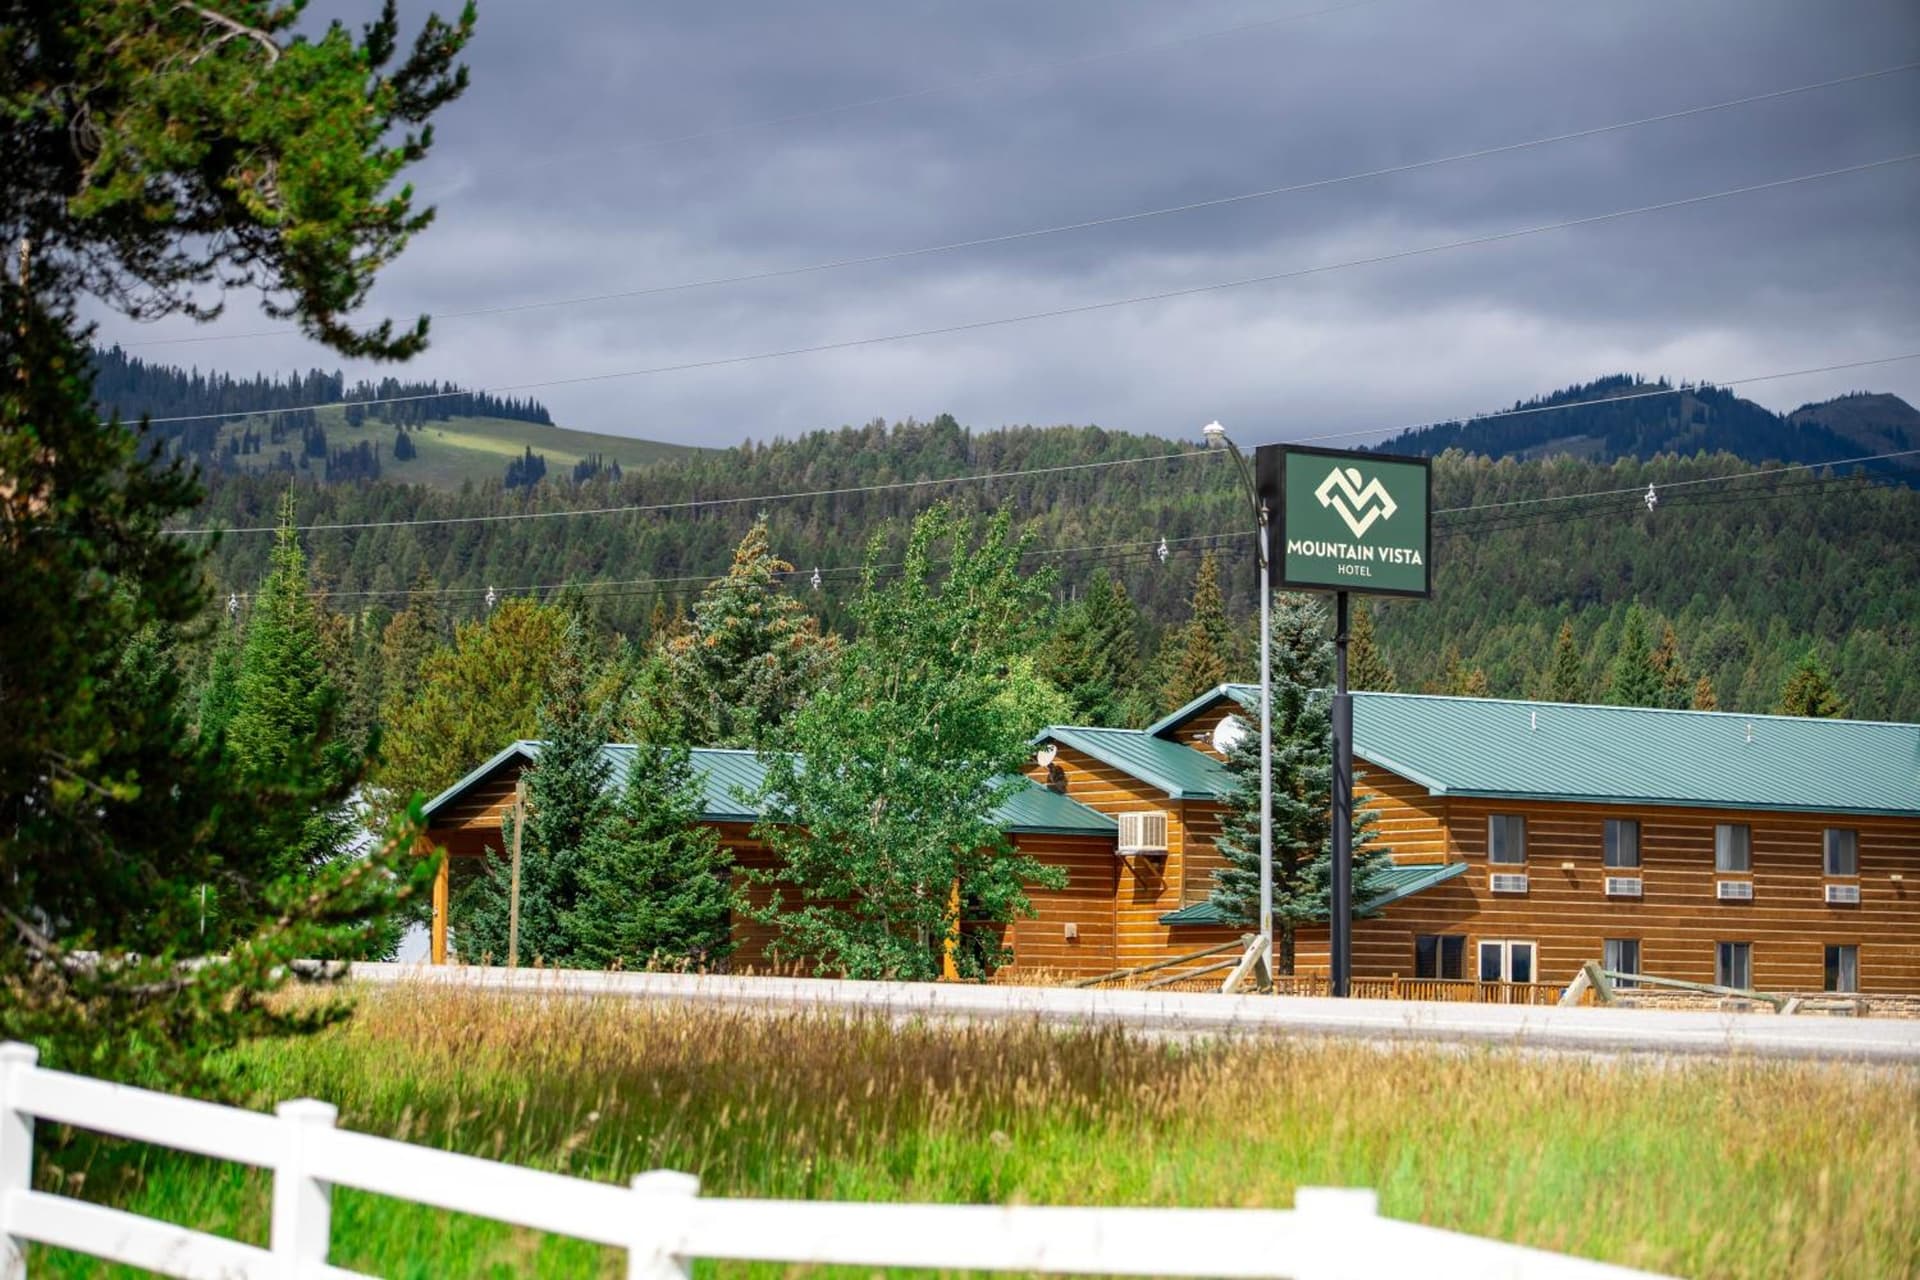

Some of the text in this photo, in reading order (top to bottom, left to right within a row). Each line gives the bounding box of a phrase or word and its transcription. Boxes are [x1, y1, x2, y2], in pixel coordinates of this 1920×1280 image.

[1287, 539, 1423, 565] MOUNTAIN VISTA
[1338, 564, 1372, 577] HOTEL
